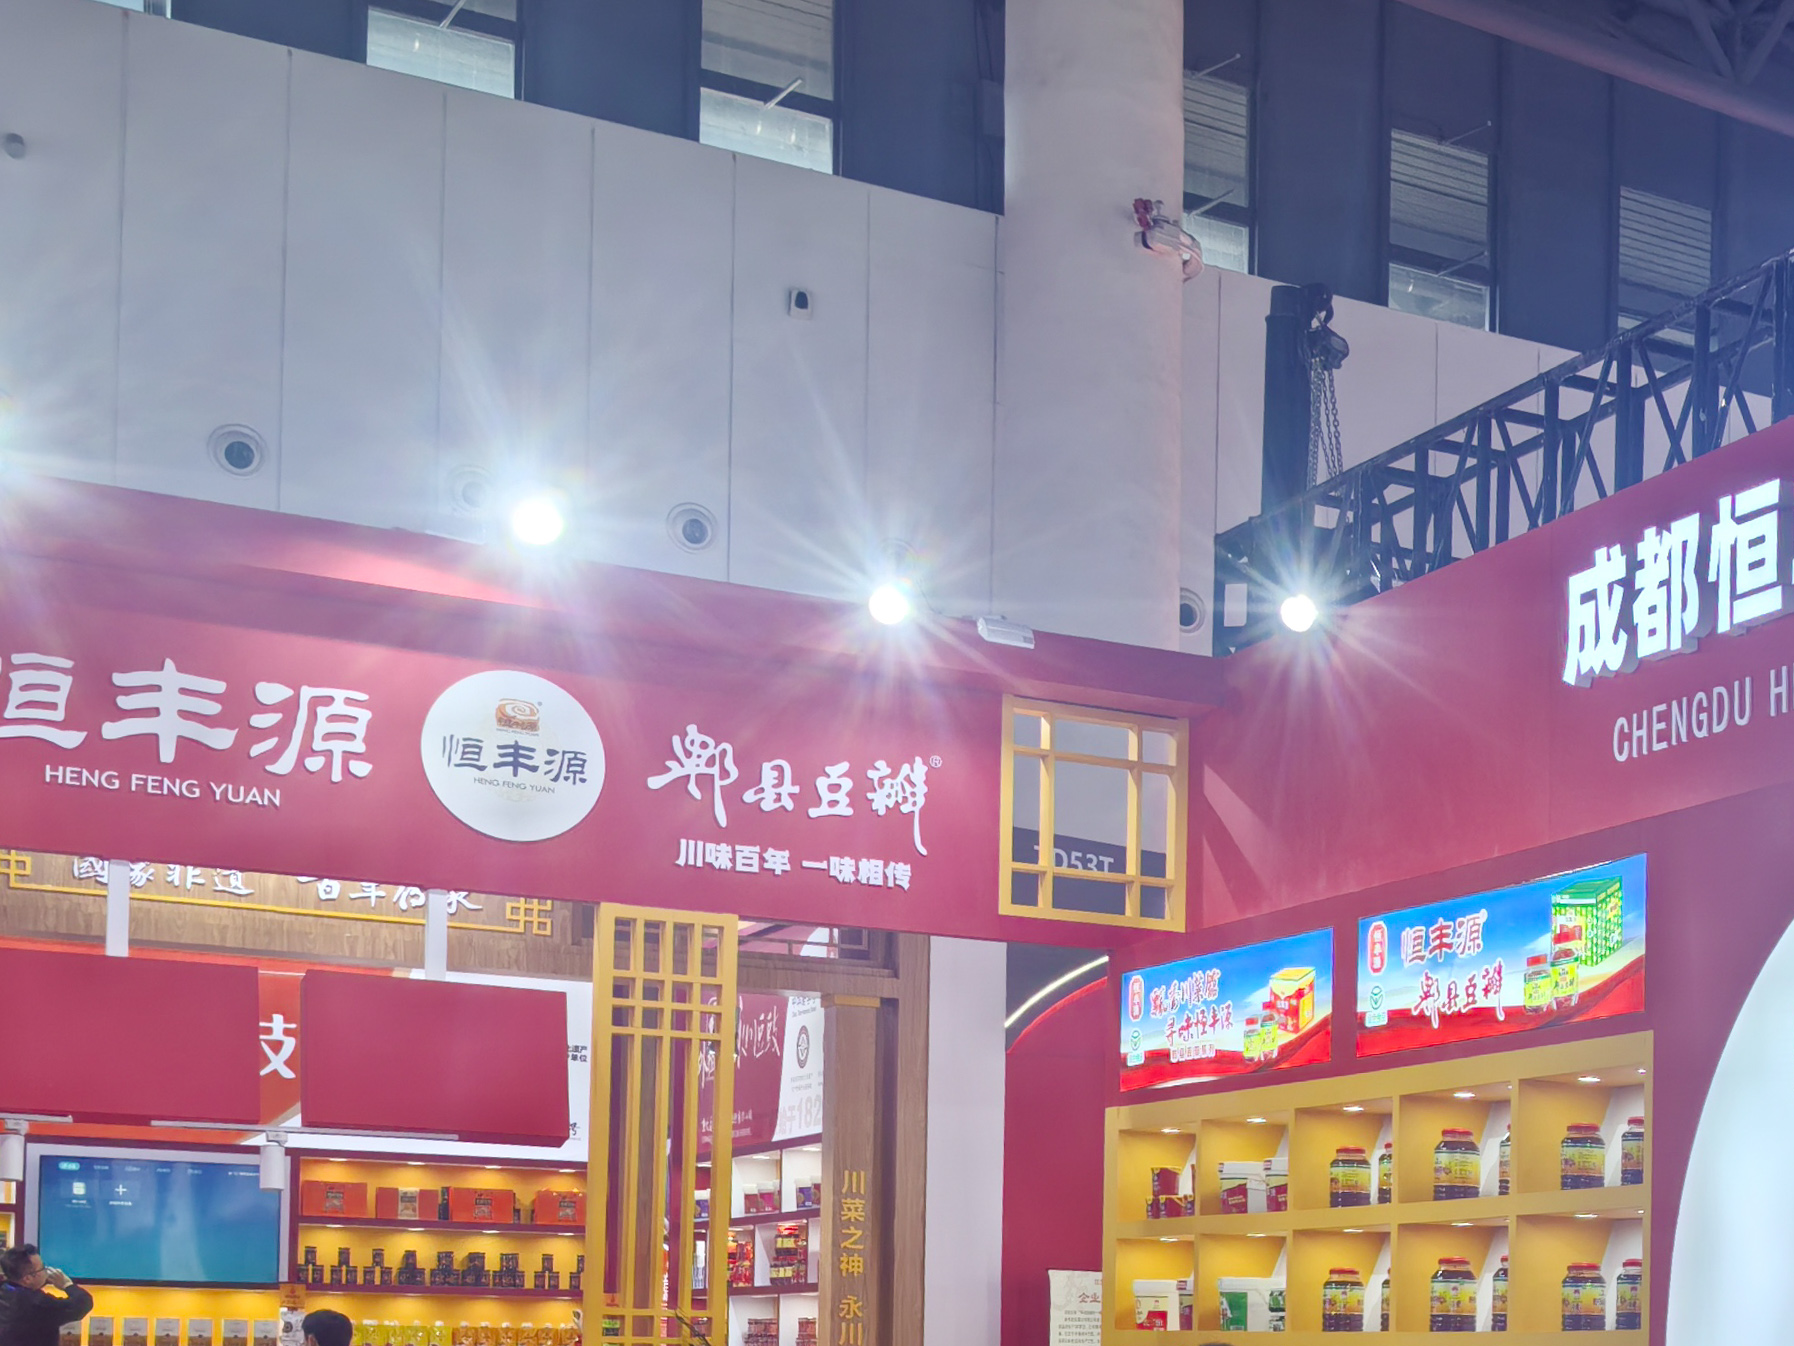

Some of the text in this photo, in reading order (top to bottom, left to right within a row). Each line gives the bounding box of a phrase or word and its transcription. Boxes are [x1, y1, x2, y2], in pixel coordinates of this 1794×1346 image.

[1612, 676, 1753, 763] CHENGDU
[44, 764, 281, 808] HENG FENG YUAN
[442, 734, 588, 786] 恒丰源
[473, 776, 556, 795] HENG FENG YUAN
[647, 724, 928, 856] 郫县豆瓣
[675, 837, 913, 890] 川味百年 一味相传
[1400, 913, 1483, 964] 恒丰源
[840, 1169, 867, 1277] 川菜之神
